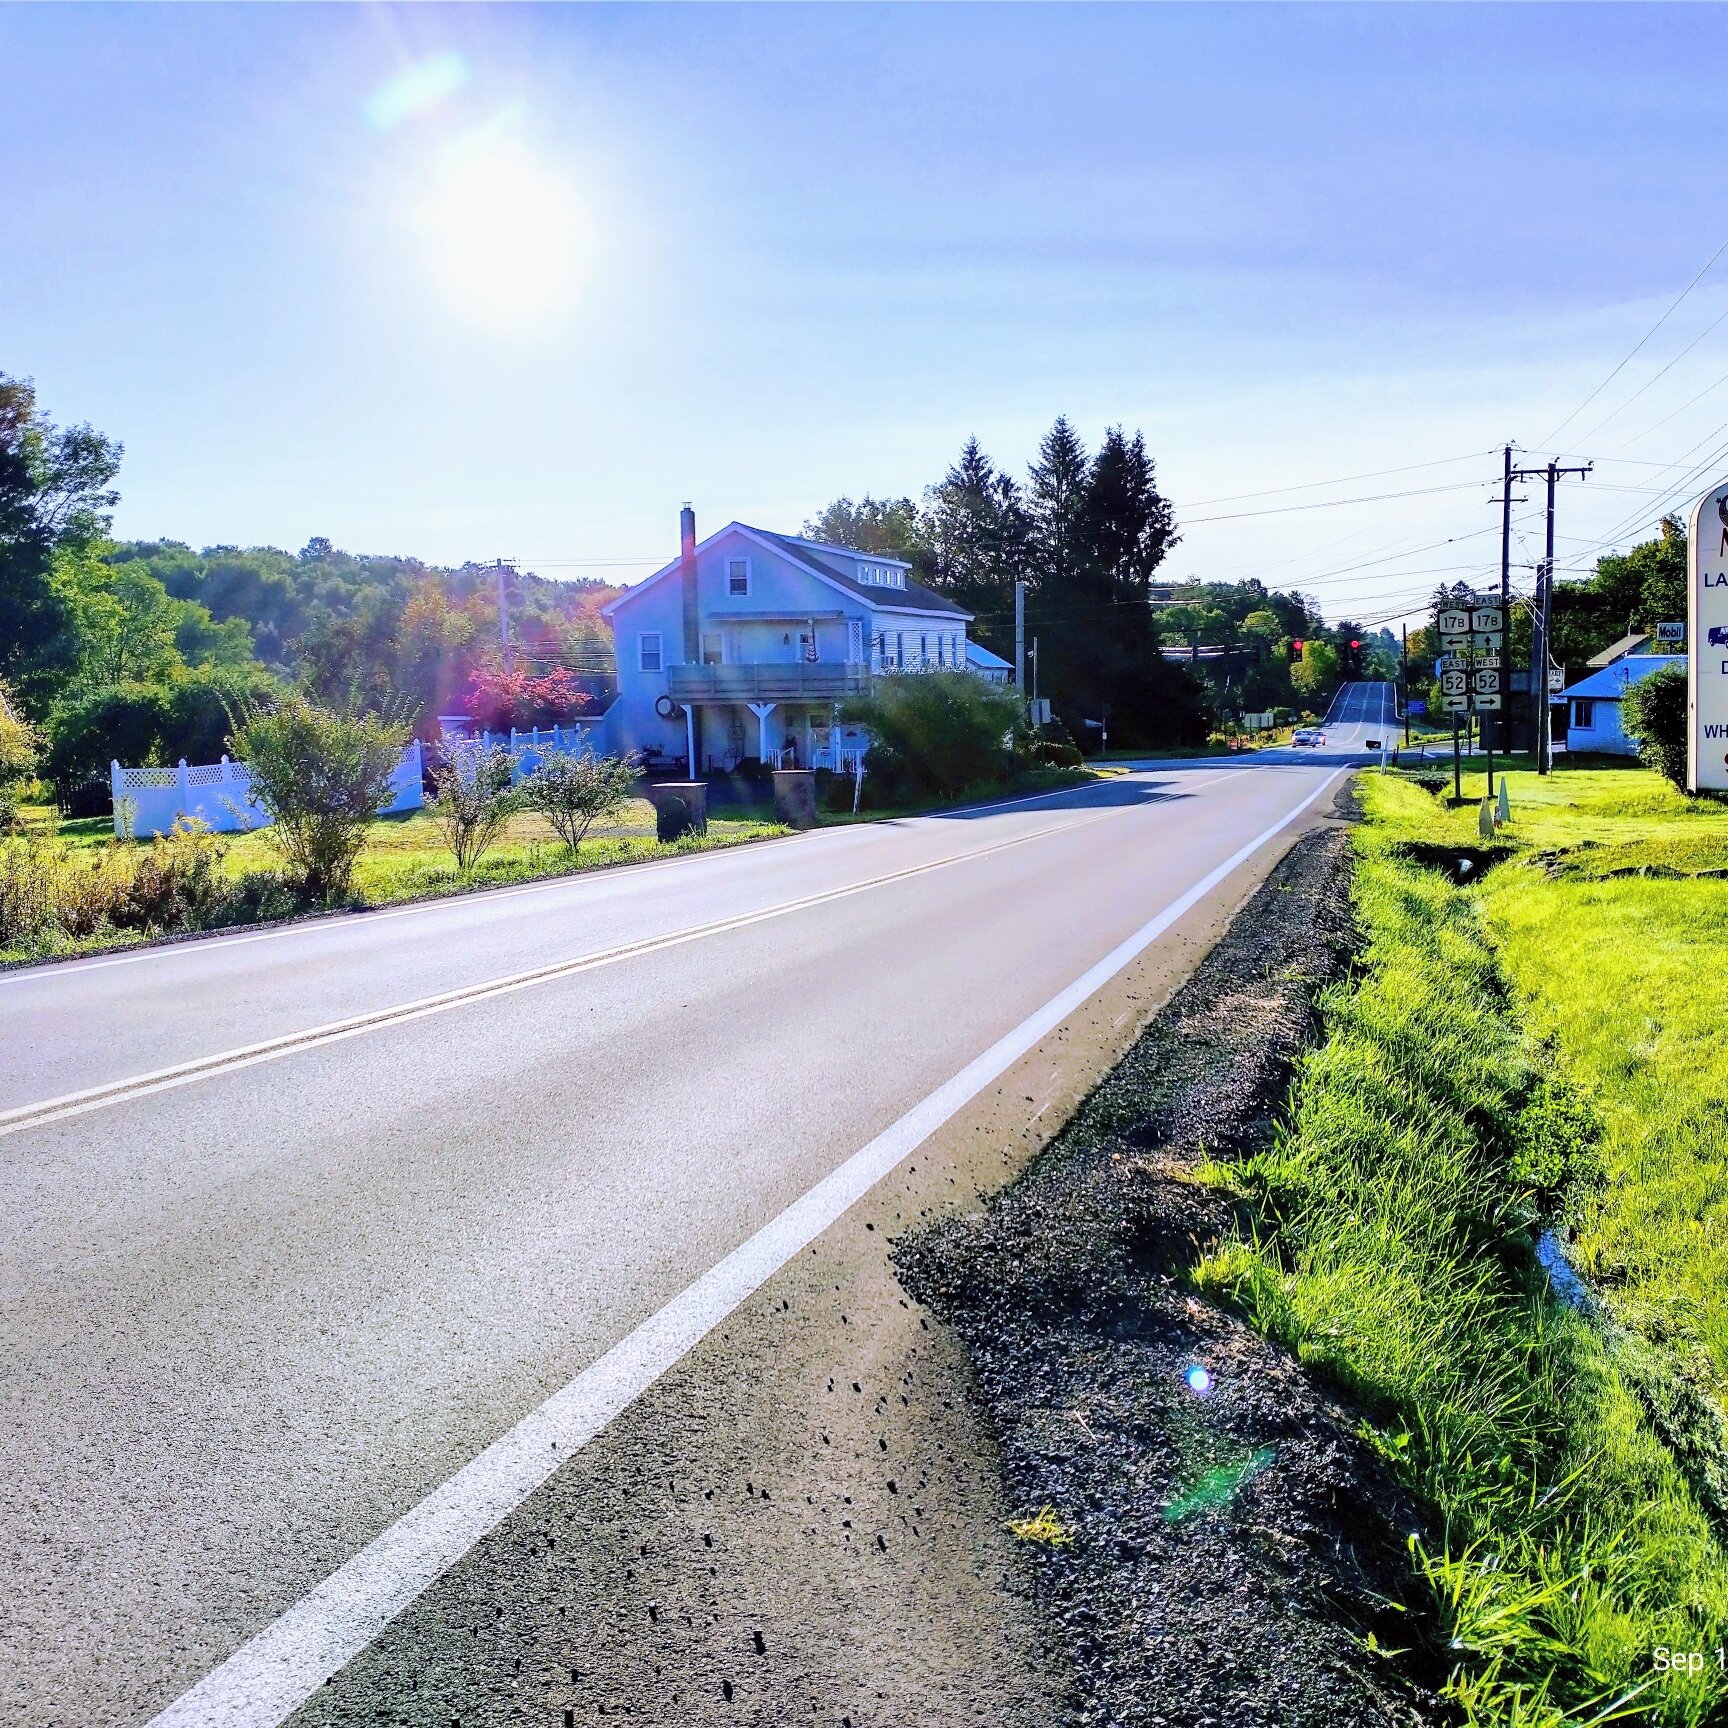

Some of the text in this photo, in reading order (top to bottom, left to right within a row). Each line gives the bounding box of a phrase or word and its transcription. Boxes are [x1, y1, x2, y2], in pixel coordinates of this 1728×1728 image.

[1442, 600, 1465, 609] WEST
[1475, 596, 1499, 605] EAST
[1444, 616, 1465, 628] 17B
[1477, 614, 1498, 627] 17B
[1658, 626, 1681, 638] Mobil
[1442, 660, 1466, 669] EAST
[1475, 658, 1499, 667] WEST
[1446, 676, 1464, 690] 52
[1479, 674, 1496, 688] 52
